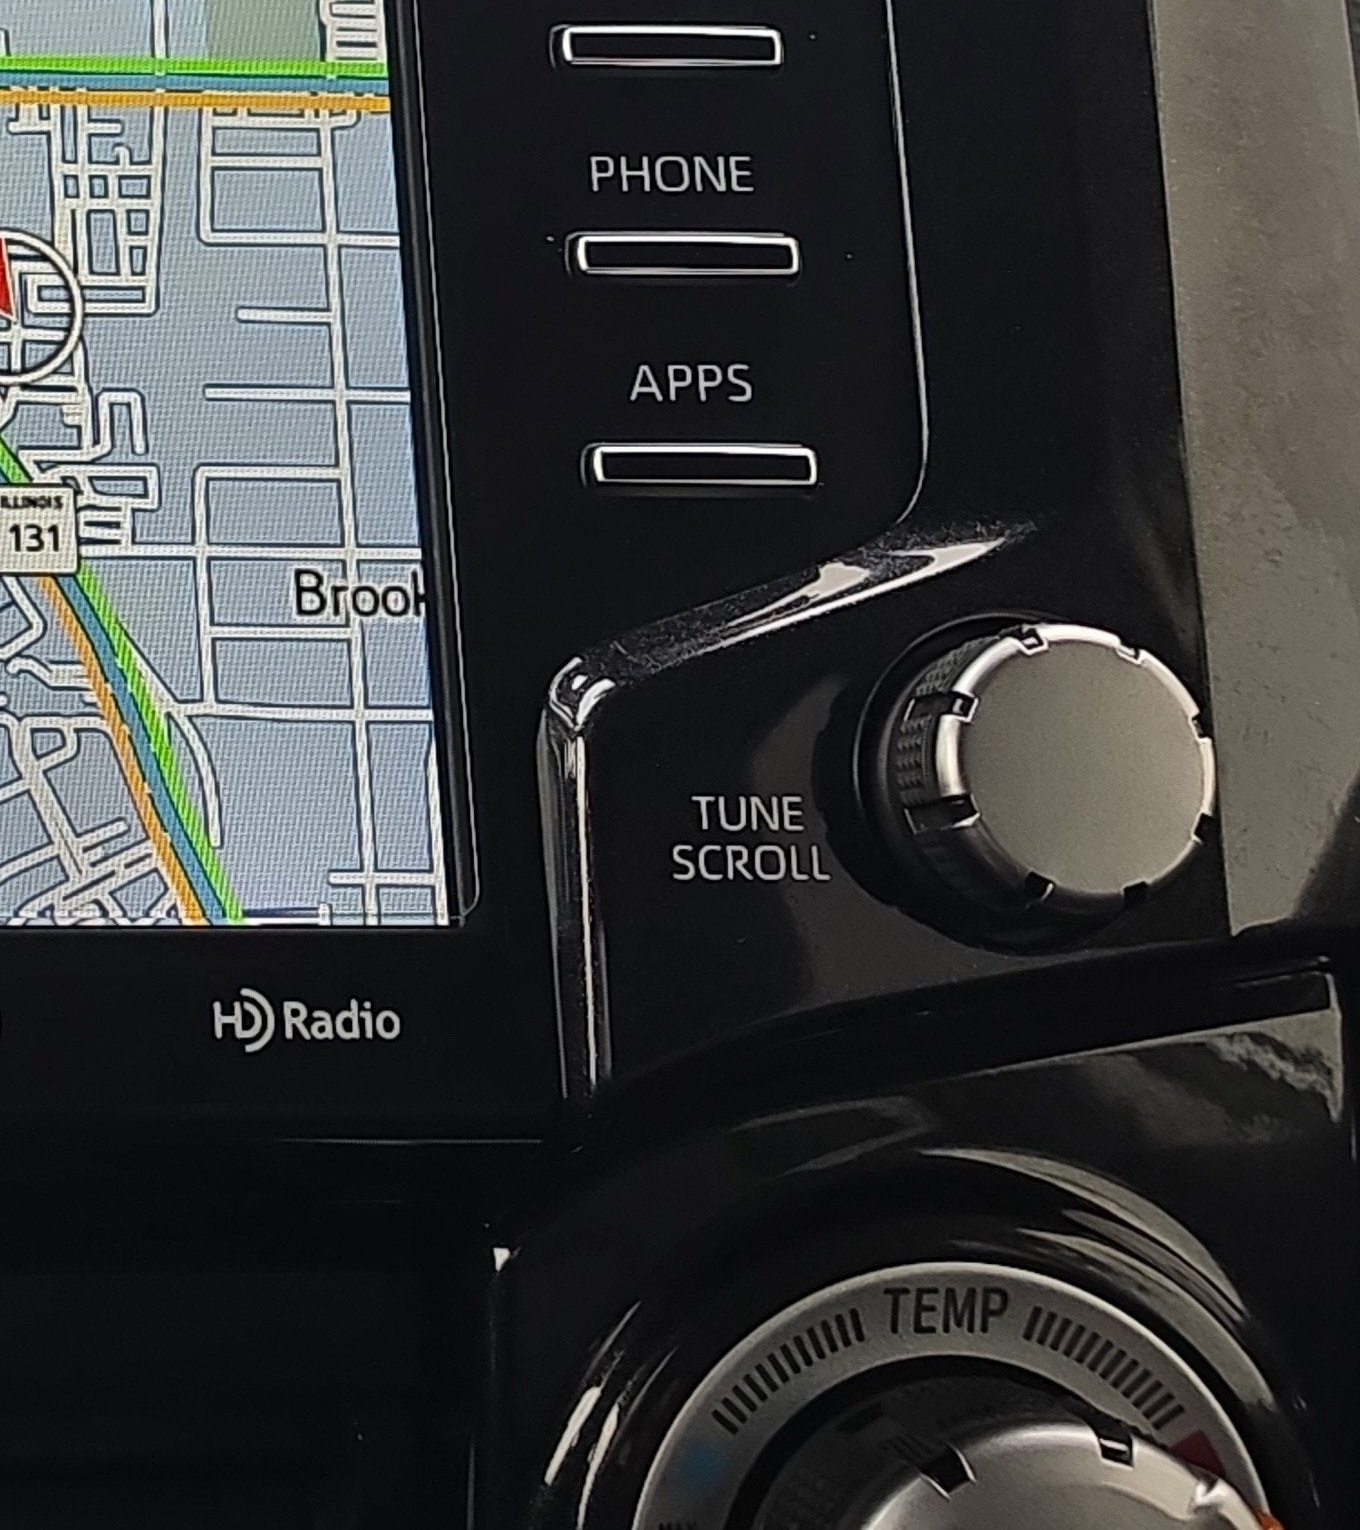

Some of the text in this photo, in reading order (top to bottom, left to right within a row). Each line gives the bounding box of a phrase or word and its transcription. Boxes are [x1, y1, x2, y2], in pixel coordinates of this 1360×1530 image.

[591, 155, 754, 192] PHONE
[630, 363, 752, 402] APPS
[9, 523, 60, 552] 131
[691, 795, 805, 832] TUNE
[672, 844, 831, 881] SCROLL
[283, 998, 401, 1040] Radio
[882, 1286, 1009, 1334] TEMP
